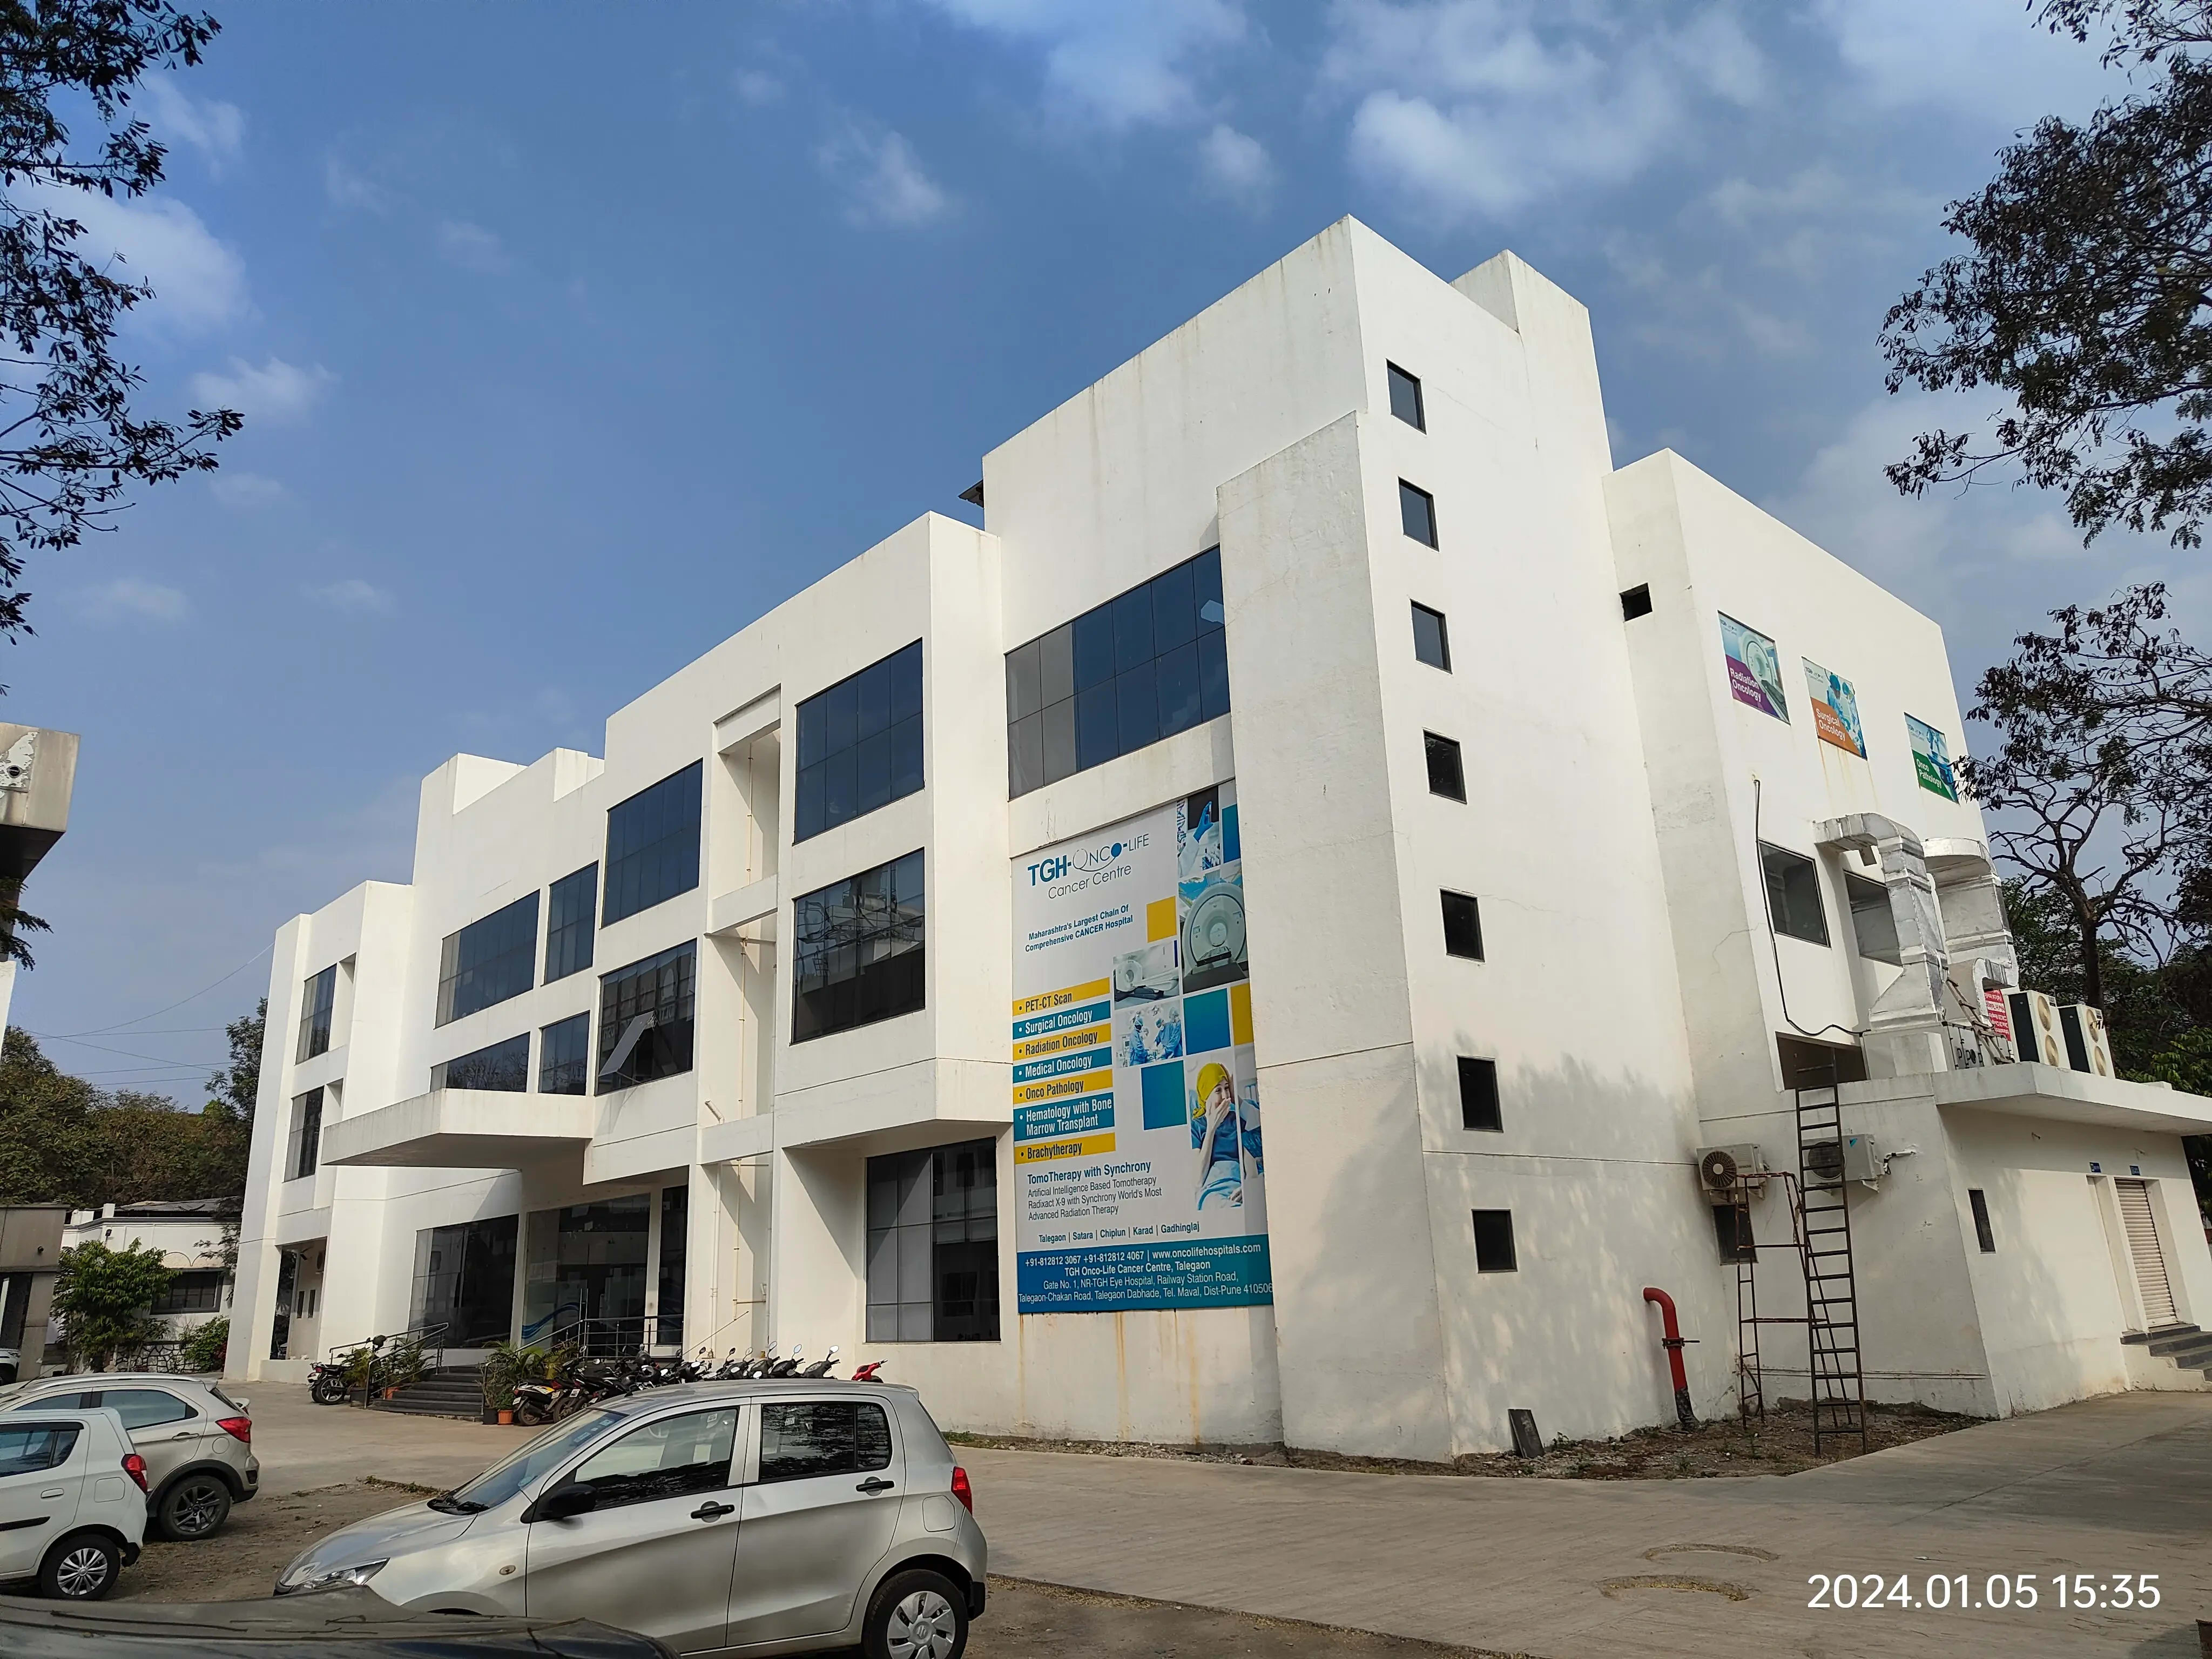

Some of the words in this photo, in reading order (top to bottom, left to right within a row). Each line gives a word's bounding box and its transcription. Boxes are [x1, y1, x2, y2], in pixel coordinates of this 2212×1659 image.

[1730, 667, 1759, 690] Radiation
[1732, 680, 1761, 702] Oncology
[1816, 708, 1840, 727] Surgical
[1819, 719, 1845, 741] Oncology
[1917, 759, 1929, 772] Onco
[1918, 768, 1941, 788] Pathology
[1048, 878, 1090, 899] Cancer
[1092, 865, 1131, 885] Centre
[1029, 922, 1072, 940] Maharashtra's
[1074, 914, 1098, 927] Largest
[1100, 908, 1119, 920] Chain
[1121, 904, 1129, 913] Of
[1026, 934, 1074, 952] Comprehensive
[1075, 924, 1103, 938] CANCER
[1105, 915, 1133, 929] Hospital
[1026, 996, 1052, 1012] PET-CT
[1054, 993, 1072, 1006] Scan
[1026, 1016, 1055, 1034] Surgical
[1057, 1010, 1092, 1026] Oncology
[1026, 1039, 1060, 1055] Radiation
[1063, 1032, 1097, 1048] Oncology
[1026, 1061, 1055, 1077] Medical
[1057, 1056, 1092, 1071] Oncology
[1026, 1088, 1044, 1100] Onco
[1047, 1081, 1084, 1096] Pathology
[1027, 1105, 1071, 1122] Hematology
[1073, 1101, 1089, 1114] with
[1091, 1098, 1112, 1111] Bone
[1027, 1122, 1055, 1136] Marrow
[1057, 1114, 1098, 1131] Transplant
[1028, 1143, 1082, 1159] Brachytherapy
[1028, 1170, 1082, 1184] TomoTherapy
[1084, 1165, 1101, 1177] with
[1104, 1162, 1151, 1177] Synchrony
[1028, 1186, 1051, 1197] Artificial
[1053, 1183, 1088, 1196] Intelligence
[1090, 1180, 1111, 1190] Based
[1112, 1176, 1157, 1189] Tomotherapy
[1028, 1198, 1054, 1209] Radixact
[1055, 1197, 1065, 1206] X-9
[1067, 1195, 1080, 1205] with
[1081, 1192, 1116, 1205] Synchrony
[1117, 1189, 1143, 1200] World's
[1144, 1187, 1162, 1197] Most
[1028, 1210, 1058, 1220] Advanced
[1061, 1207, 1090, 1218] Radiation
[1091, 1204, 1119, 1216] Therapy
[1039, 1232, 1066, 1244] Talegaon
[1073, 1231, 1093, 1240] Satara
[1100, 1228, 1125, 1239] Chiplun
[1133, 1225, 1154, 1236] Karad
[1161, 1221, 1199, 1233] Gadhinglaj
[1025, 1256, 1063, 1267] +91-812812
[1064, 1256, 1081, 1264] 3067
[1083, 1252, 1125, 1263] +91-812812
[1127, 1251, 1144, 1260] 4067
[1152, 1244, 1261, 1259] www.oncolifehospitals.com
[1064, 1267, 1080, 1276] TGH
[1081, 1265, 1116, 1276] Onco-Life
[1117, 1264, 1144, 1273] Cancer
[1145, 1263, 1173, 1272] Centre,
[1175, 1261, 1211, 1272] Talegaon
[1043, 1280, 1058, 1290] Gate
[1060, 1279, 1071, 1289] No.
[1073, 1280, 1079, 1289] 1,
[1081, 1278, 1108, 1288] NR-TGH
[1110, 1277, 1123, 1289] Eye
[1124, 1275, 1155, 1288] Hospital,
[1157, 1275, 1185, 1286] Railway
[1187, 1273, 1213, 1283] Station
[1215, 1271, 1238, 1282] Road,
[1018, 1292, 1073, 1304] Talegaon-Chakan
[1074, 1291, 1093, 1301] Road,
[1094, 1290, 1125, 1301] Talegaon
[1127, 1287, 1161, 1299] Dabhade,
[1177, 1286, 1202, 1297] Maval,
[1204, 1285, 1242, 1296] Dist-Pune
[1243, 1283, 1272, 1293] 410506
